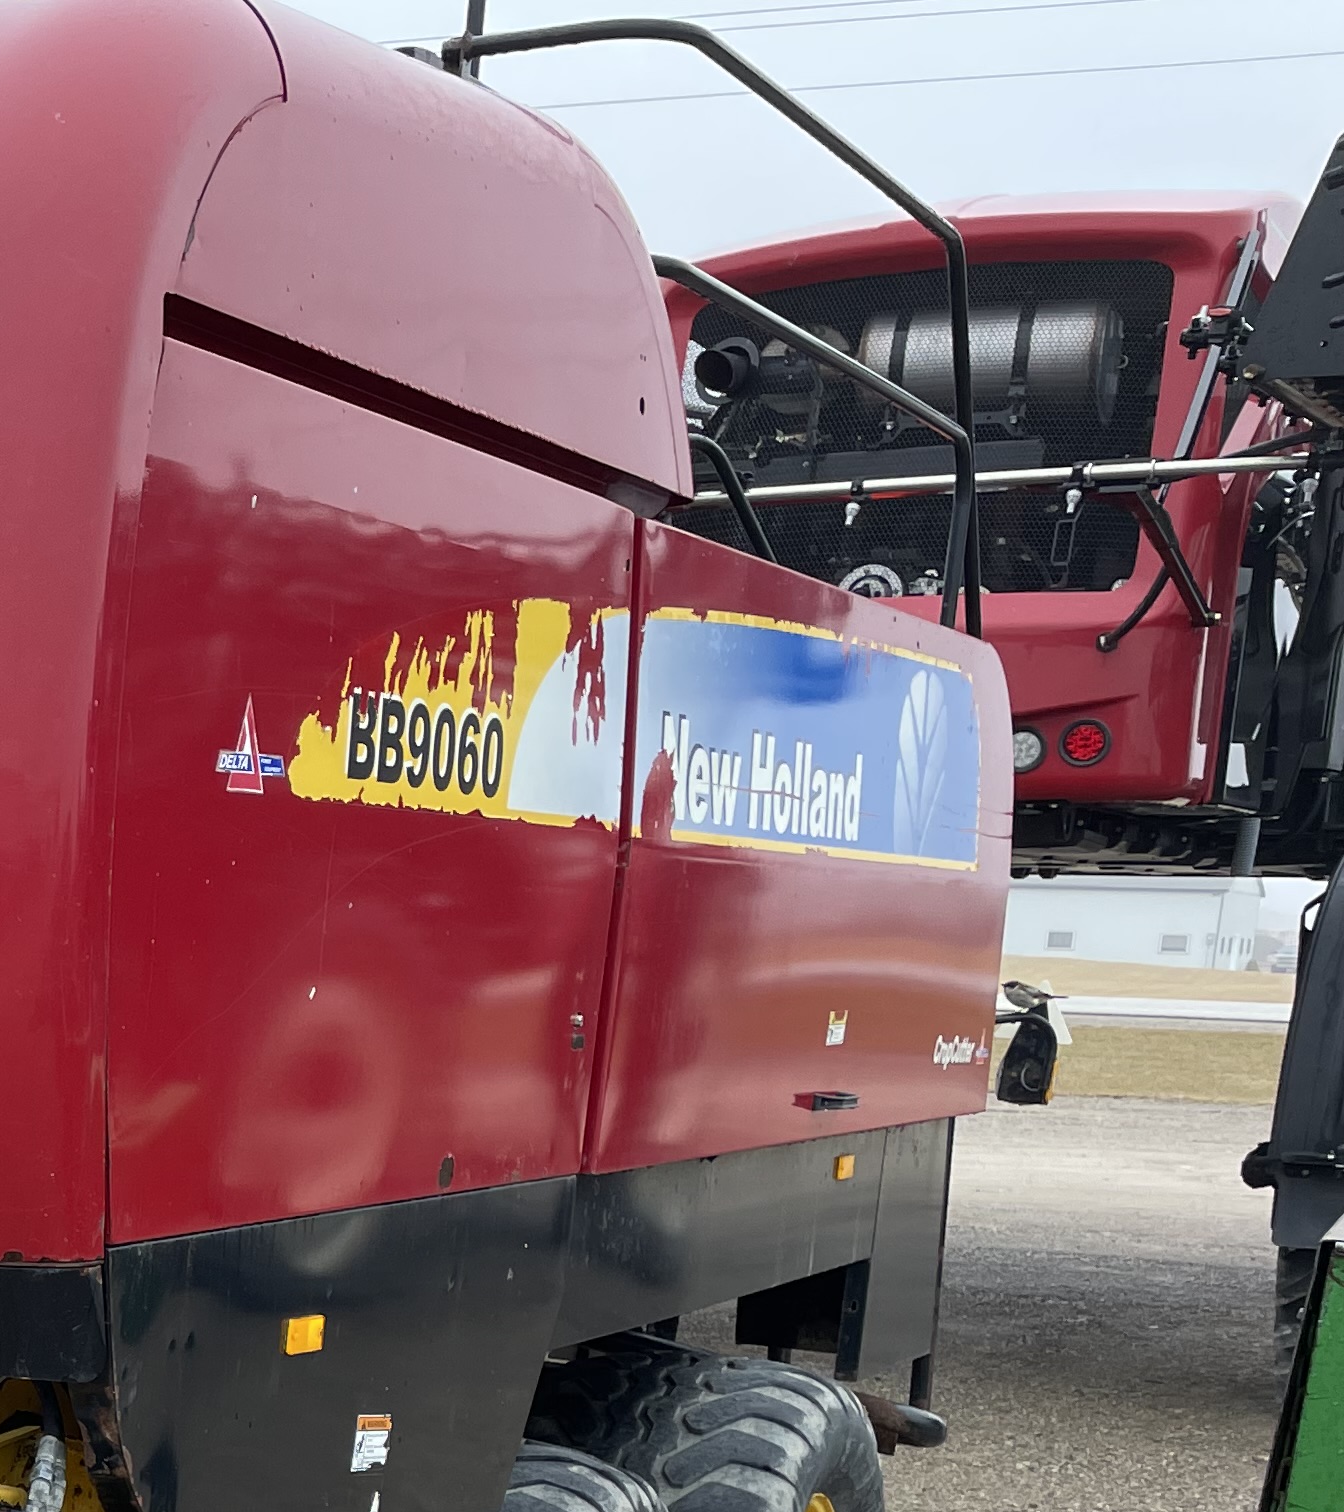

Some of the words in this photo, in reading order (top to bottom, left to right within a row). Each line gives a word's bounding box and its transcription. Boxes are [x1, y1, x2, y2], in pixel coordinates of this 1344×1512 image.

[219, 754, 249, 770] DELTA
[346, 690, 505, 799] BB9060
[662, 710, 743, 828] New
[748, 728, 864, 842] Holland
